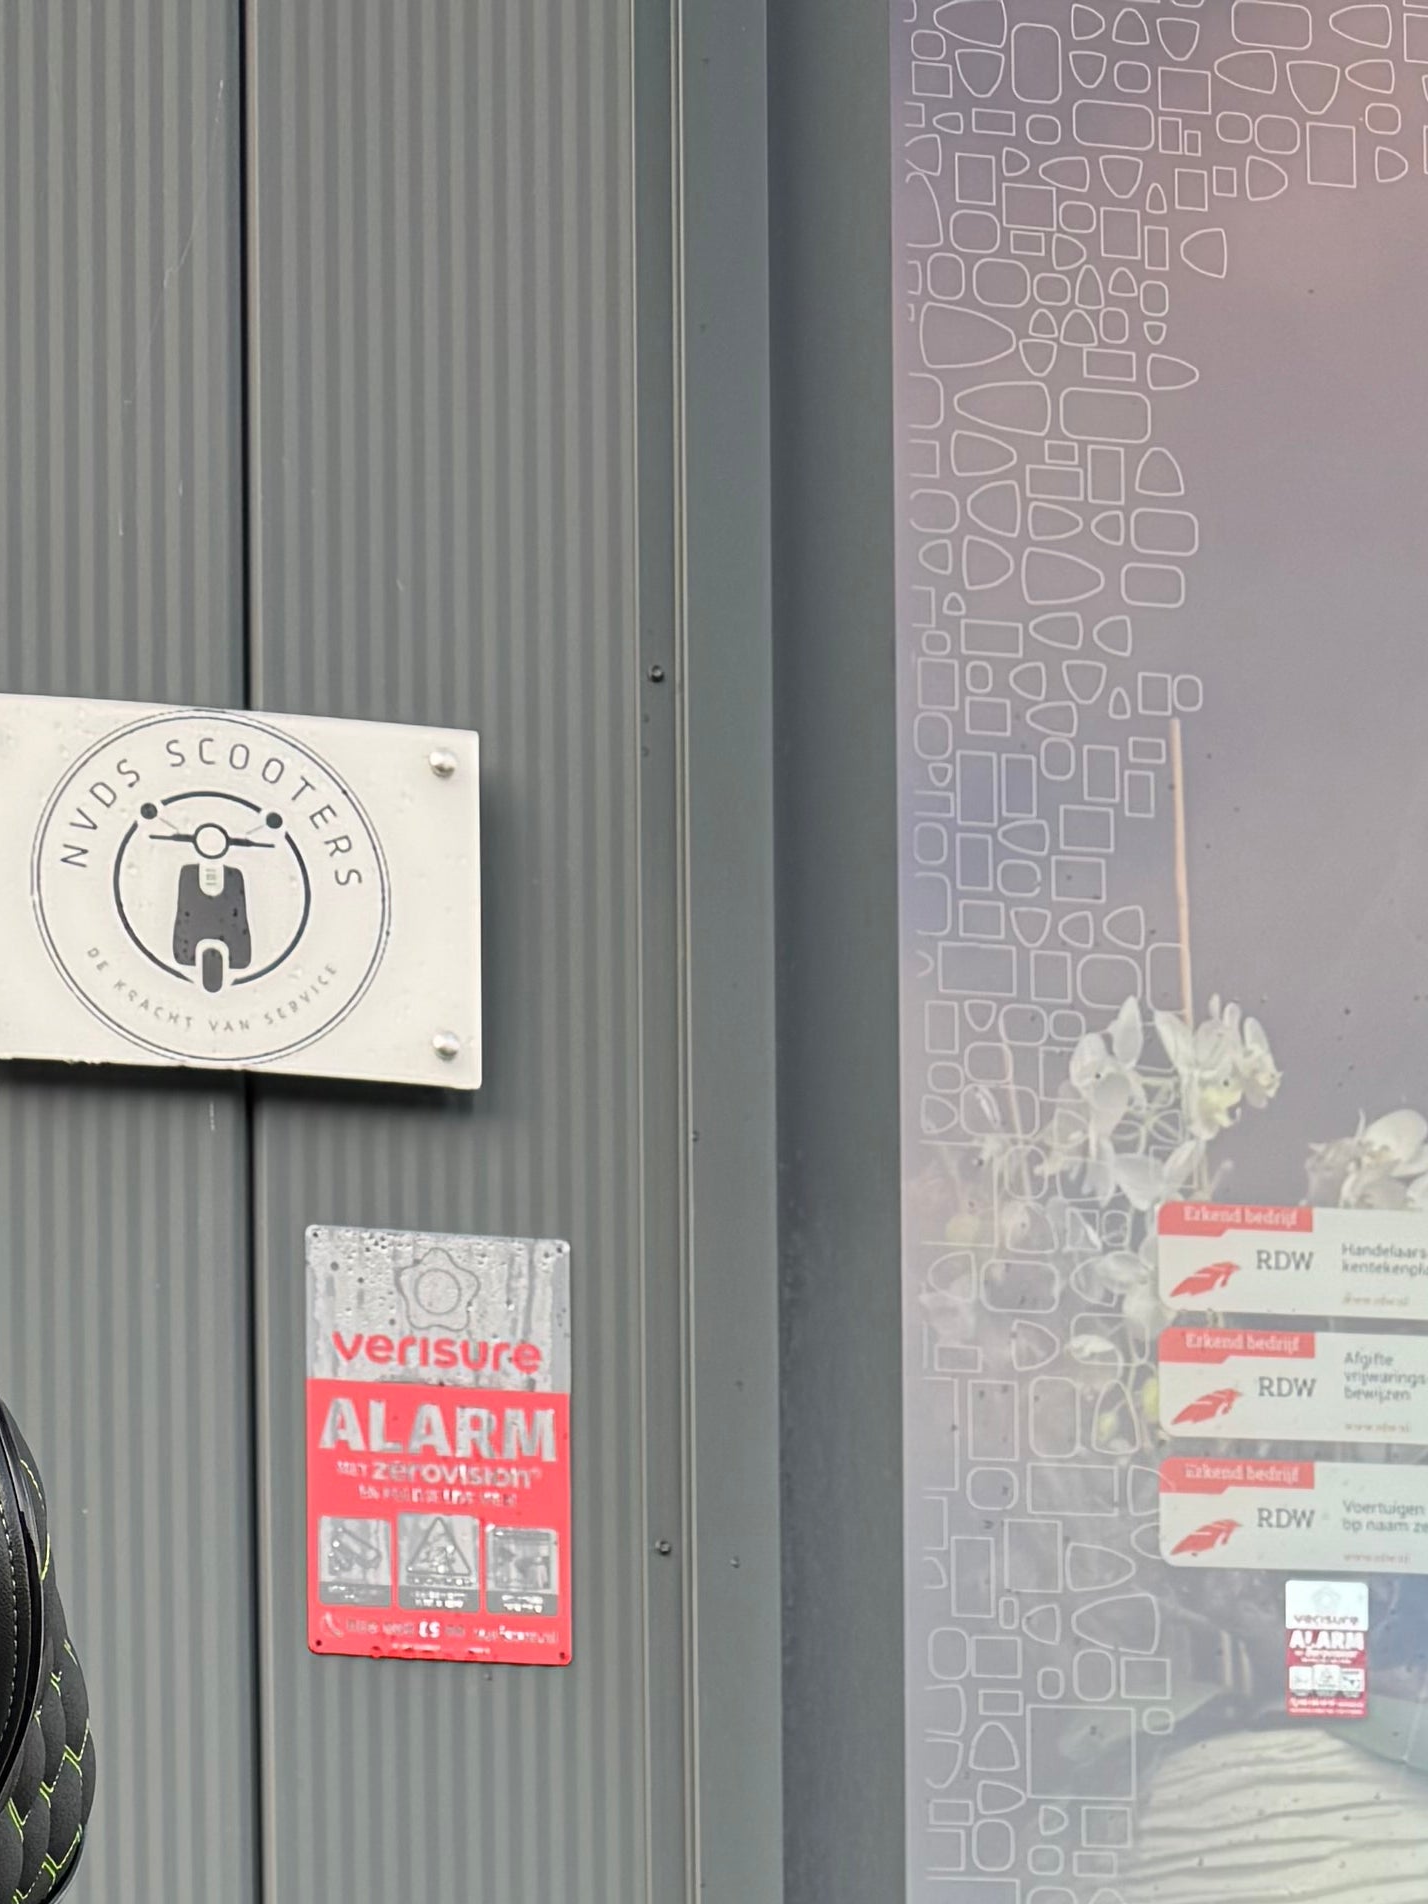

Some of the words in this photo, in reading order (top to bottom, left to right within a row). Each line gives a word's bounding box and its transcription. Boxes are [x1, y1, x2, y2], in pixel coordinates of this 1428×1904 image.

[61, 760, 140, 867] NVDS
[166, 737, 362, 886] SCOOTERS
[209, 1020, 250, 1032] VAN
[1184, 1206, 1241, 1225] Erkend
[1245, 1207, 1297, 1227] bedrijf
[1256, 1249, 1314, 1271] RDW
[332, 1331, 542, 1374] verisure
[1185, 1333, 1244, 1351] Erkend
[1247, 1334, 1300, 1353] bedrijf
[1258, 1376, 1316, 1398] RDW
[319, 1398, 557, 1463] ALARM
[1185, 1464, 1244, 1480] Erkend
[1247, 1465, 1300, 1484] bedrijf
[1257, 1508, 1315, 1529] RDW
[1342, 1500, 1426, 1519] Voertuigen
[1289, 1629, 1364, 1650] ALARM
